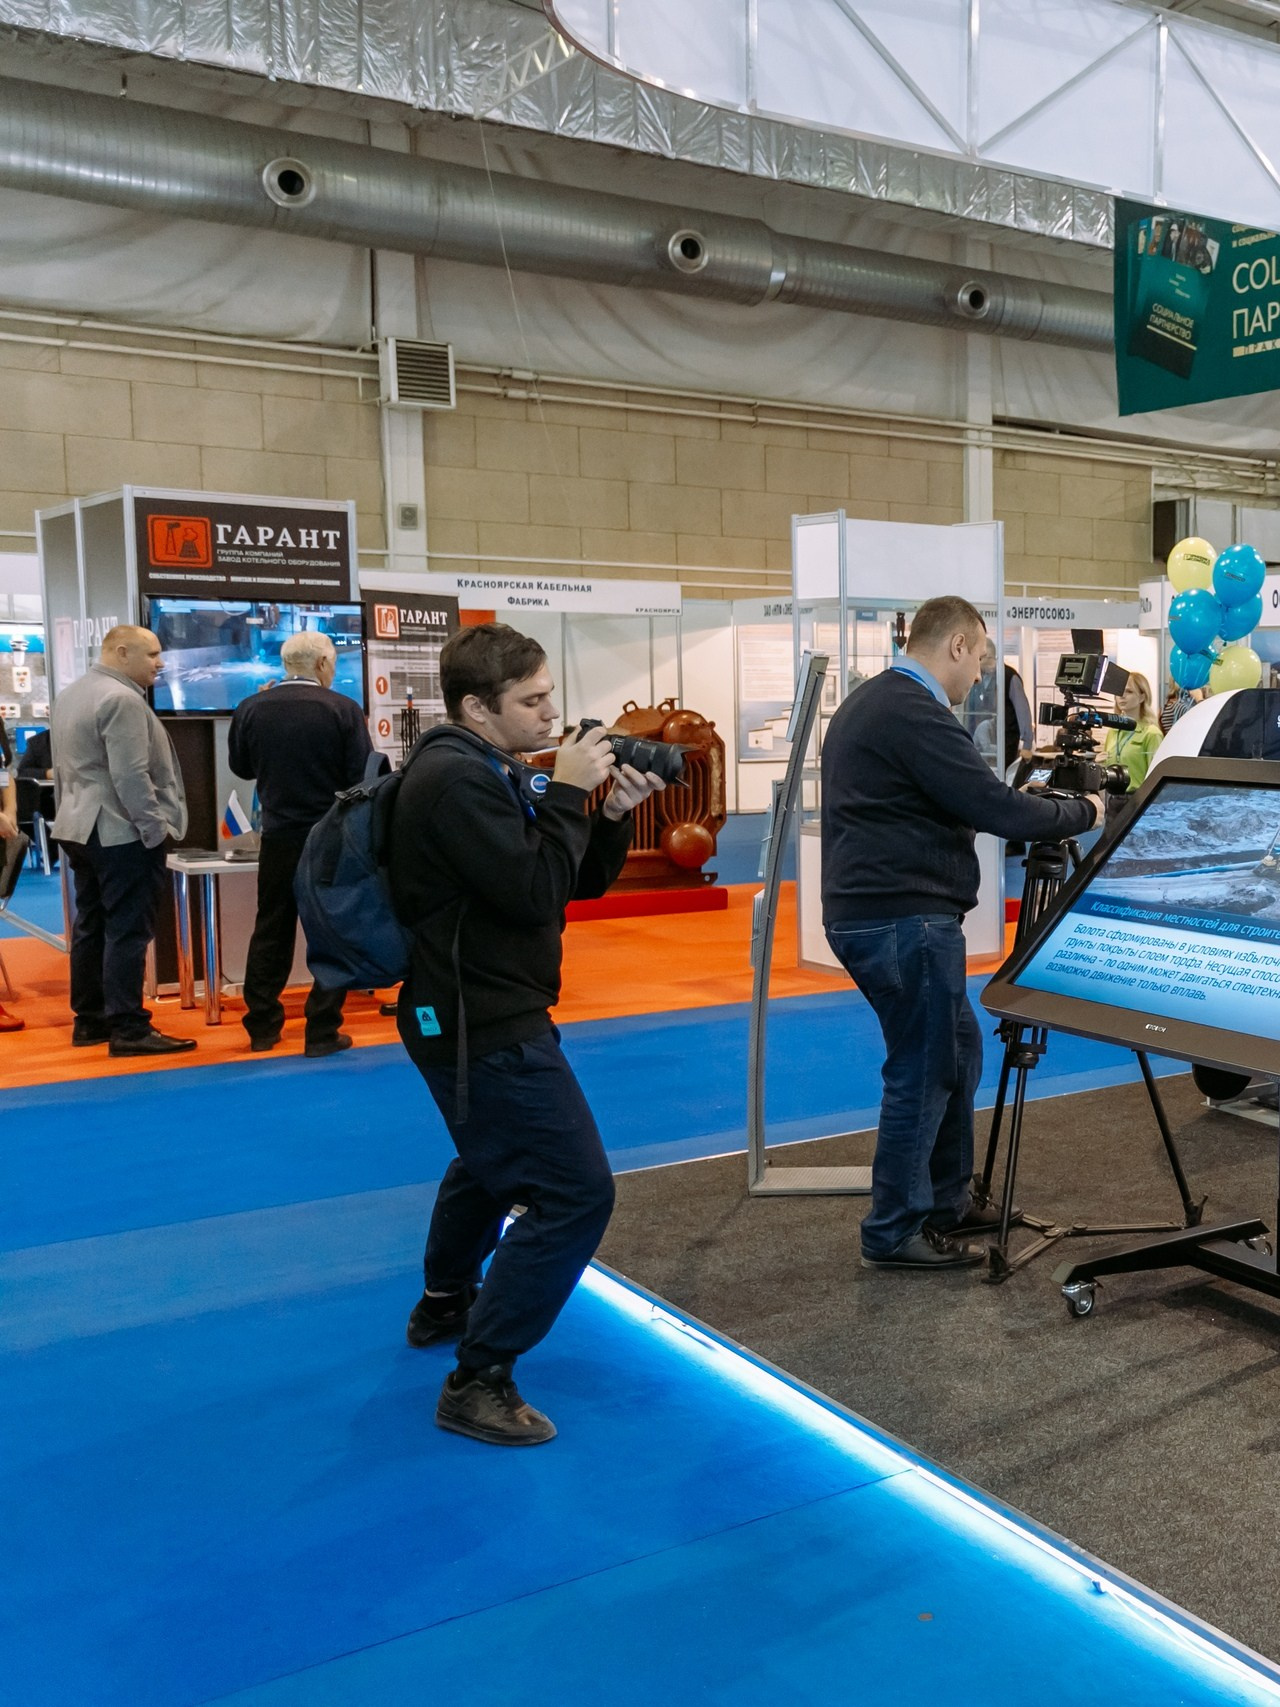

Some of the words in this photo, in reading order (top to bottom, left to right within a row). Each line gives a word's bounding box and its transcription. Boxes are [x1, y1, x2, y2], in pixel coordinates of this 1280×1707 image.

[1150, 314, 1191, 340] ПАРТНЕРСТВО
[215, 523, 341, 550] ГАРАНТ
[216, 549, 244, 557] ГРУППА
[244, 550, 284, 558] КОМПАНИЙ
[217, 556, 242, 564] ЗАВОД
[242, 557, 287, 565] КОТЕЛЬНОГО
[288, 559, 341, 567] ОБОРУДОВАНИЯ
[400, 608, 448, 626] ГАРАНТ
[1006, 606, 1075, 620] «ЭНЕРГОСОЮЗ»
[1091, 901, 1162, 921] Классификация
[1163, 913, 1218, 930] местностей
[1217, 921, 1240, 933] для
[1074, 923, 1106, 937] Болота
[1105, 928, 1179, 950] сформированы
[1179, 942, 1186, 951] в
[1188, 943, 1235, 959] условиях
[1053, 950, 1098, 965] различна
[1104, 958, 1116, 968] по
[1116, 961, 1150, 974] одним
[1149, 967, 1179, 979] может
[1179, 972, 1231, 989] двигаться
[1064, 937, 1097, 950] грунты
[1095, 943, 1138, 957] покрыты
[1138, 950, 1169, 963] слоем
[1171, 955, 1202, 970] торфа.
[1204, 960, 1251, 977] Несущая
[1045, 962, 1091, 978] возможно
[1089, 971, 1137, 987] движение
[1137, 979, 1171, 993] только
[1170, 985, 1207, 1001] вплавь.
